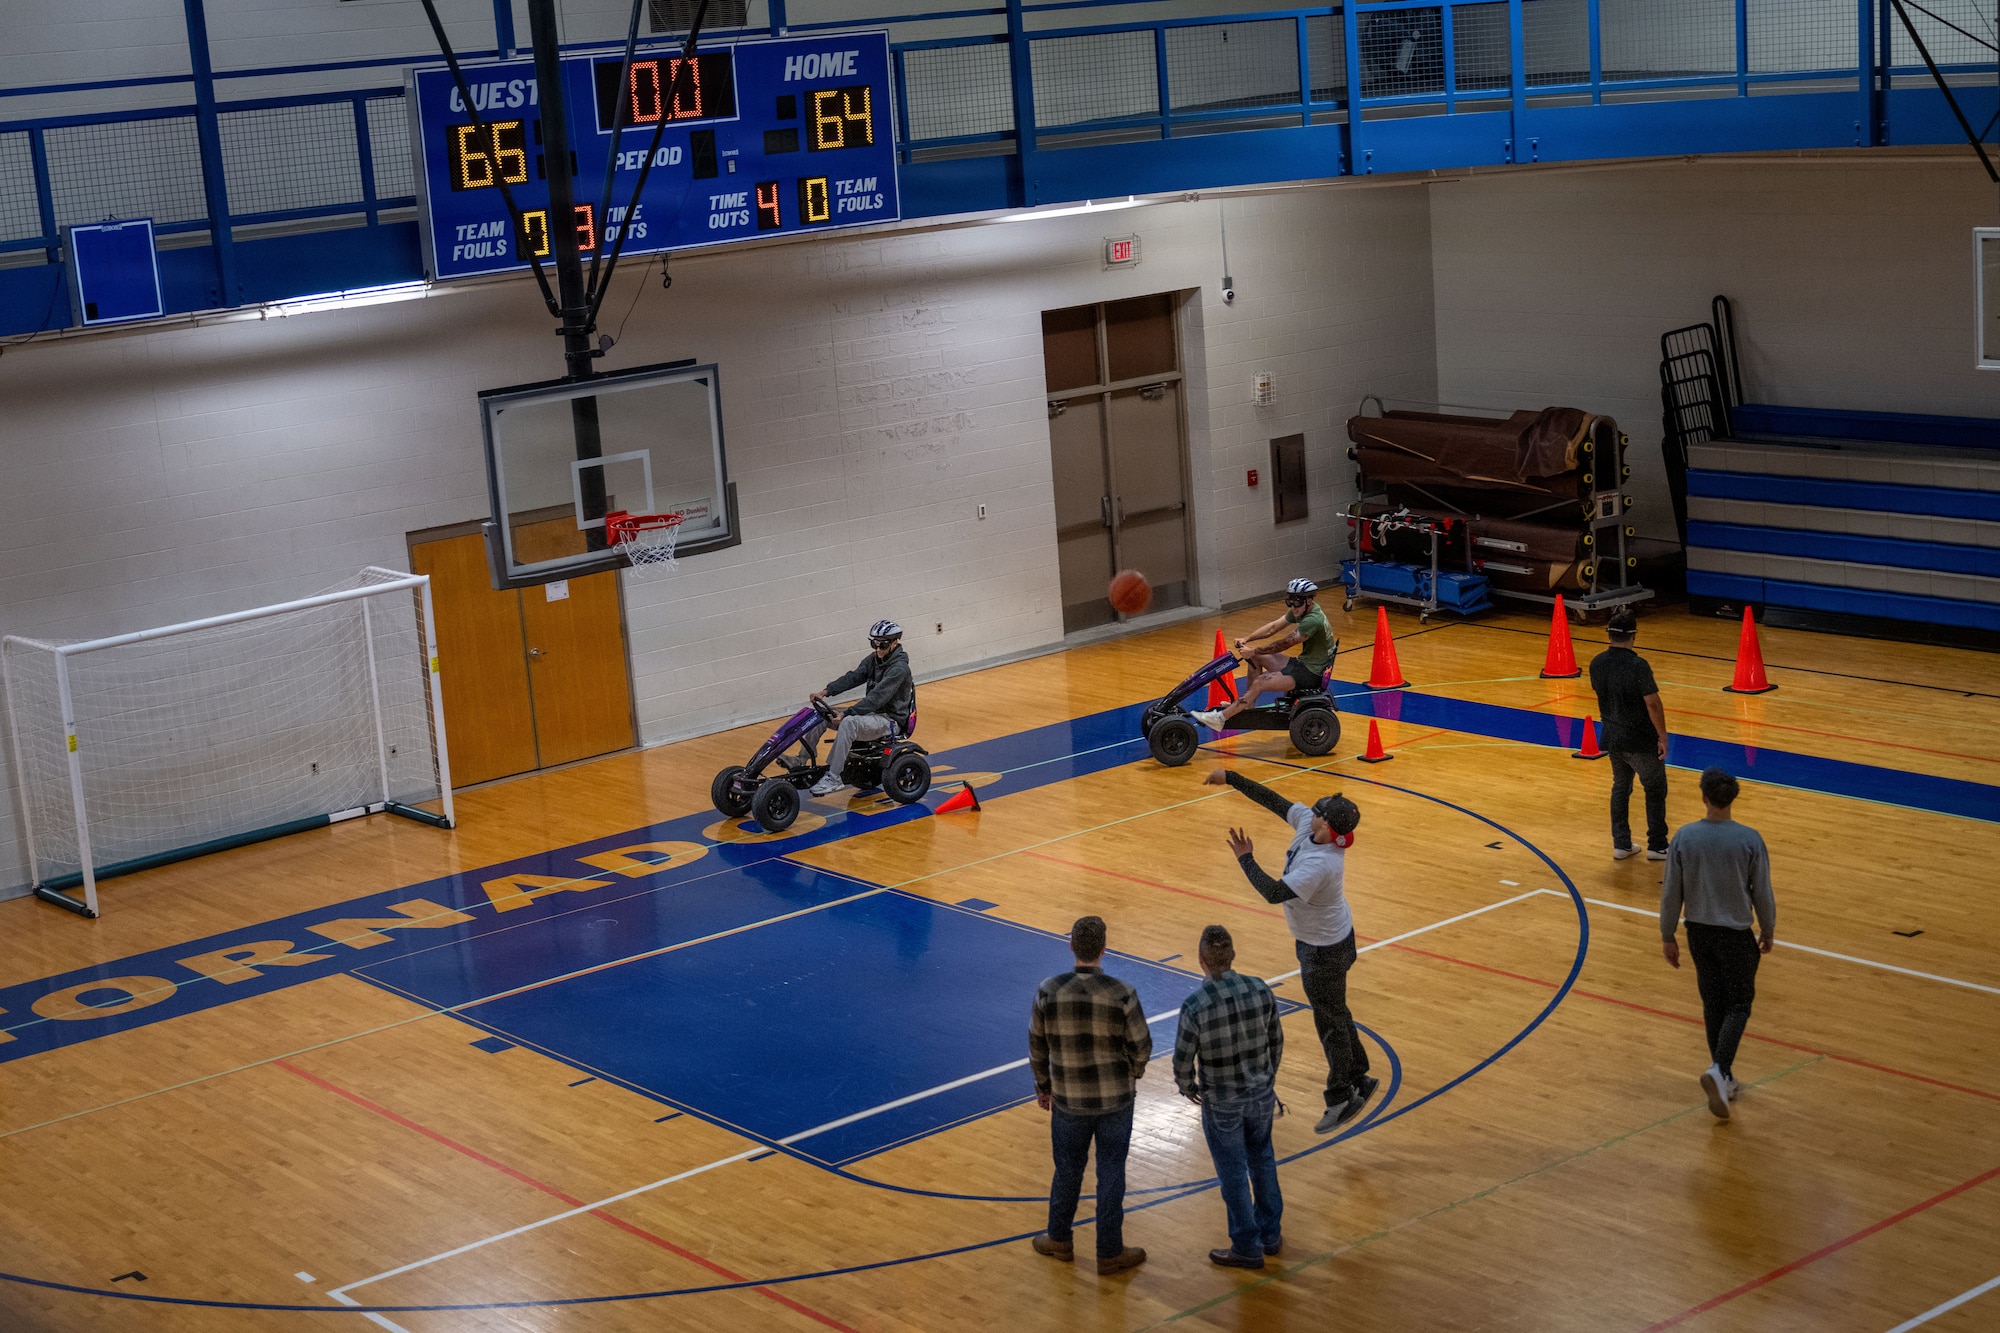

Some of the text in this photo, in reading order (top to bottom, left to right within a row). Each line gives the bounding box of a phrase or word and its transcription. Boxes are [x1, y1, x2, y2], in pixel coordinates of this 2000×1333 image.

[784, 50, 859, 81] HOME
[450, 79, 538, 112] GUEST
[814, 87, 873, 149] 64
[835, 177, 877, 196] TEAM
[709, 192, 749, 210] TIME
[757, 183, 780, 225] 4
[806, 178, 829, 221] 0
[837, 193, 883, 213] FOULS
[709, 210, 749, 229] OUTS
[456, 220, 505, 242] TEAM
[453, 239, 507, 262] FOULS
[1113, 241, 1131, 260] EXIT
